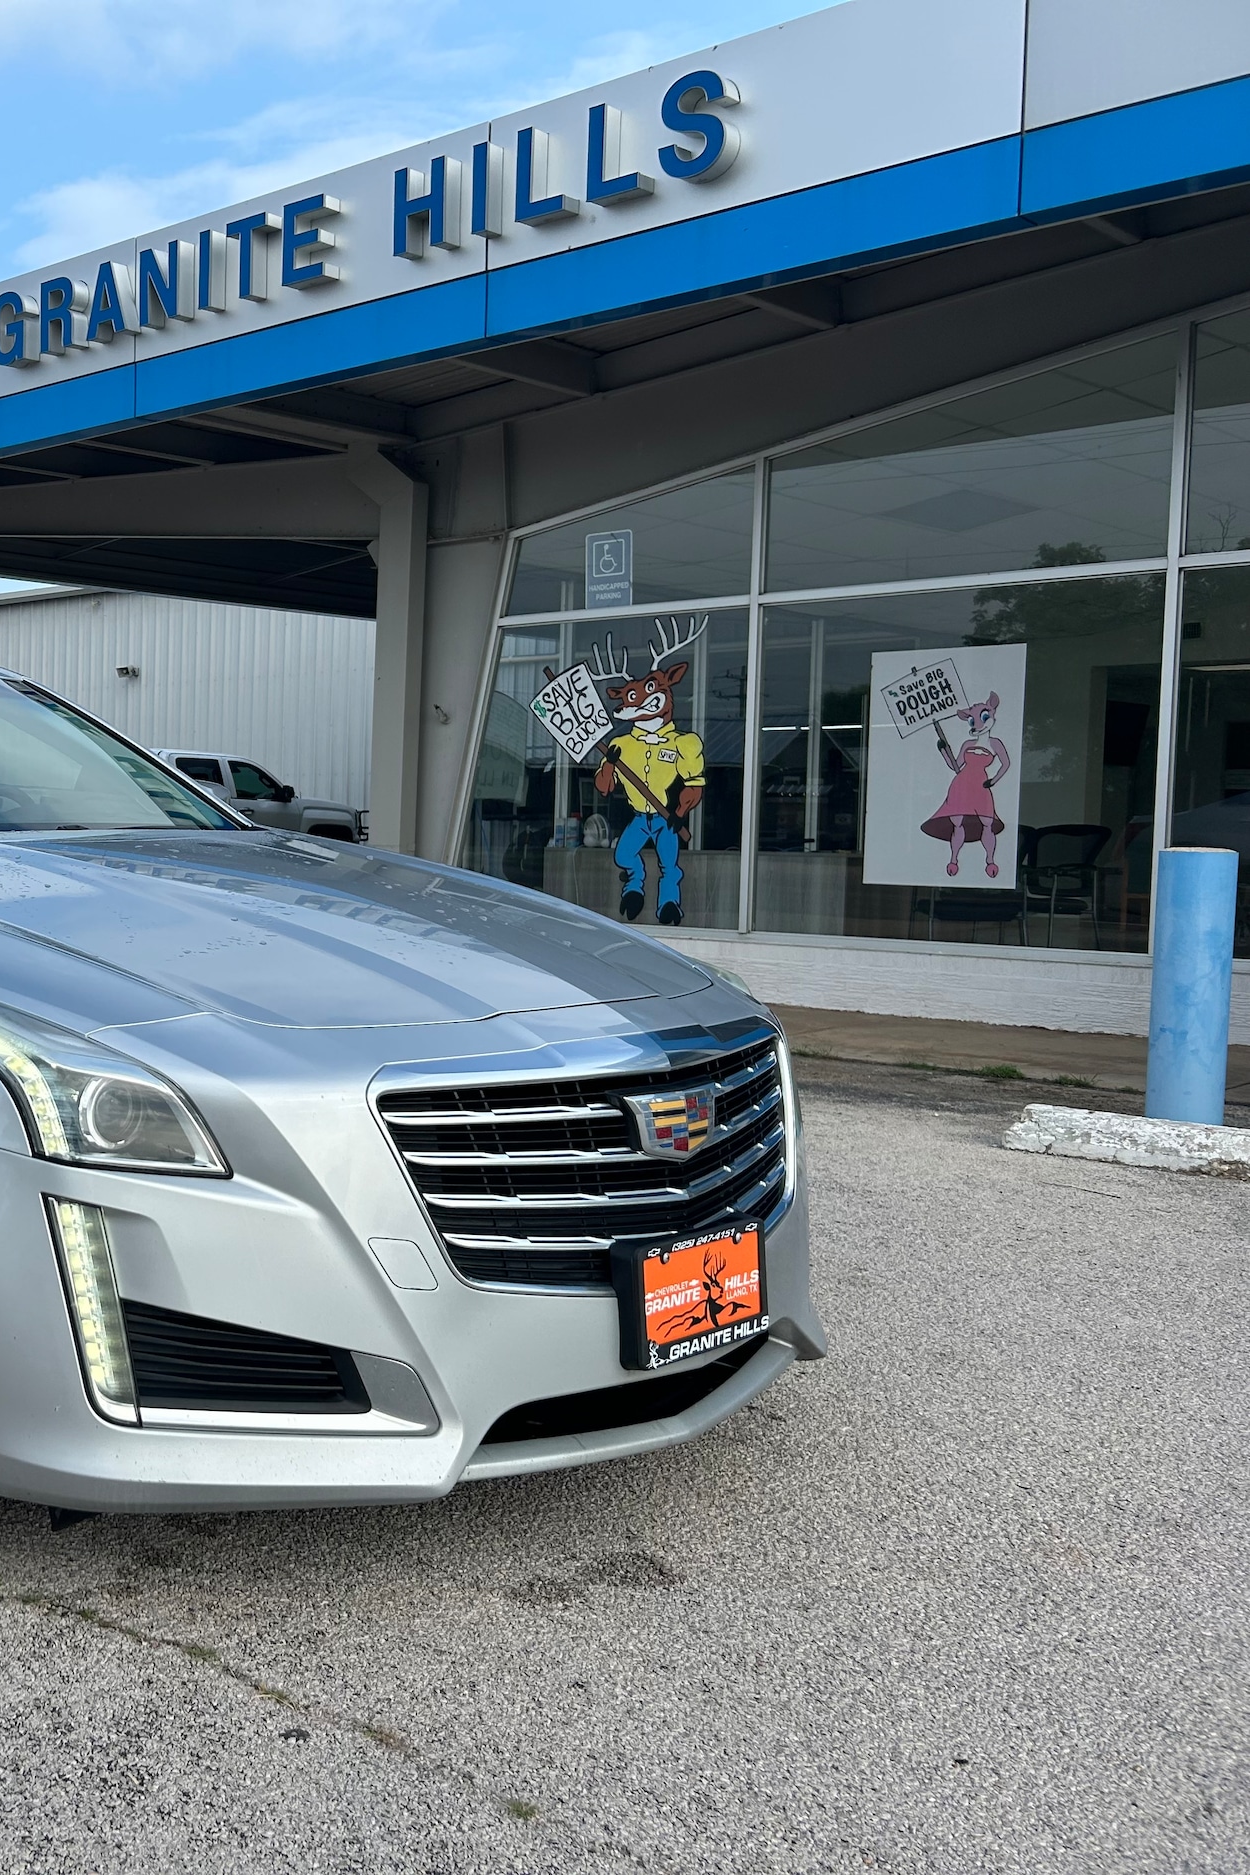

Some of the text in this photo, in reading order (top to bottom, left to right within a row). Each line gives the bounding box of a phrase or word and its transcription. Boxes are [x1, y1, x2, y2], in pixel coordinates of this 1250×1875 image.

[393, 69, 741, 260] HILLS
[589, 582, 629, 592] HANDICAPPED
[595, 592, 621, 600] PARKING
[542, 669, 588, 712] SAVE
[899, 679, 925, 695] Save
[925, 668, 944, 683] BIG
[895, 678, 953, 716] DOUGH
[916, 694, 958, 720] LLANO!
[550, 692, 594, 735] BIG
[566, 709, 610, 754] BUCKS
[671, 1238, 695, 1252] (325)
[654, 1280, 689, 1297] CHEVROLET
[724, 1269, 759, 1291] HILLS
[725, 1283, 758, 1300] LLANO, TX
[645, 1287, 701, 1316] GRANITE
[669, 1315, 769, 1360] GRANITE HILLS
